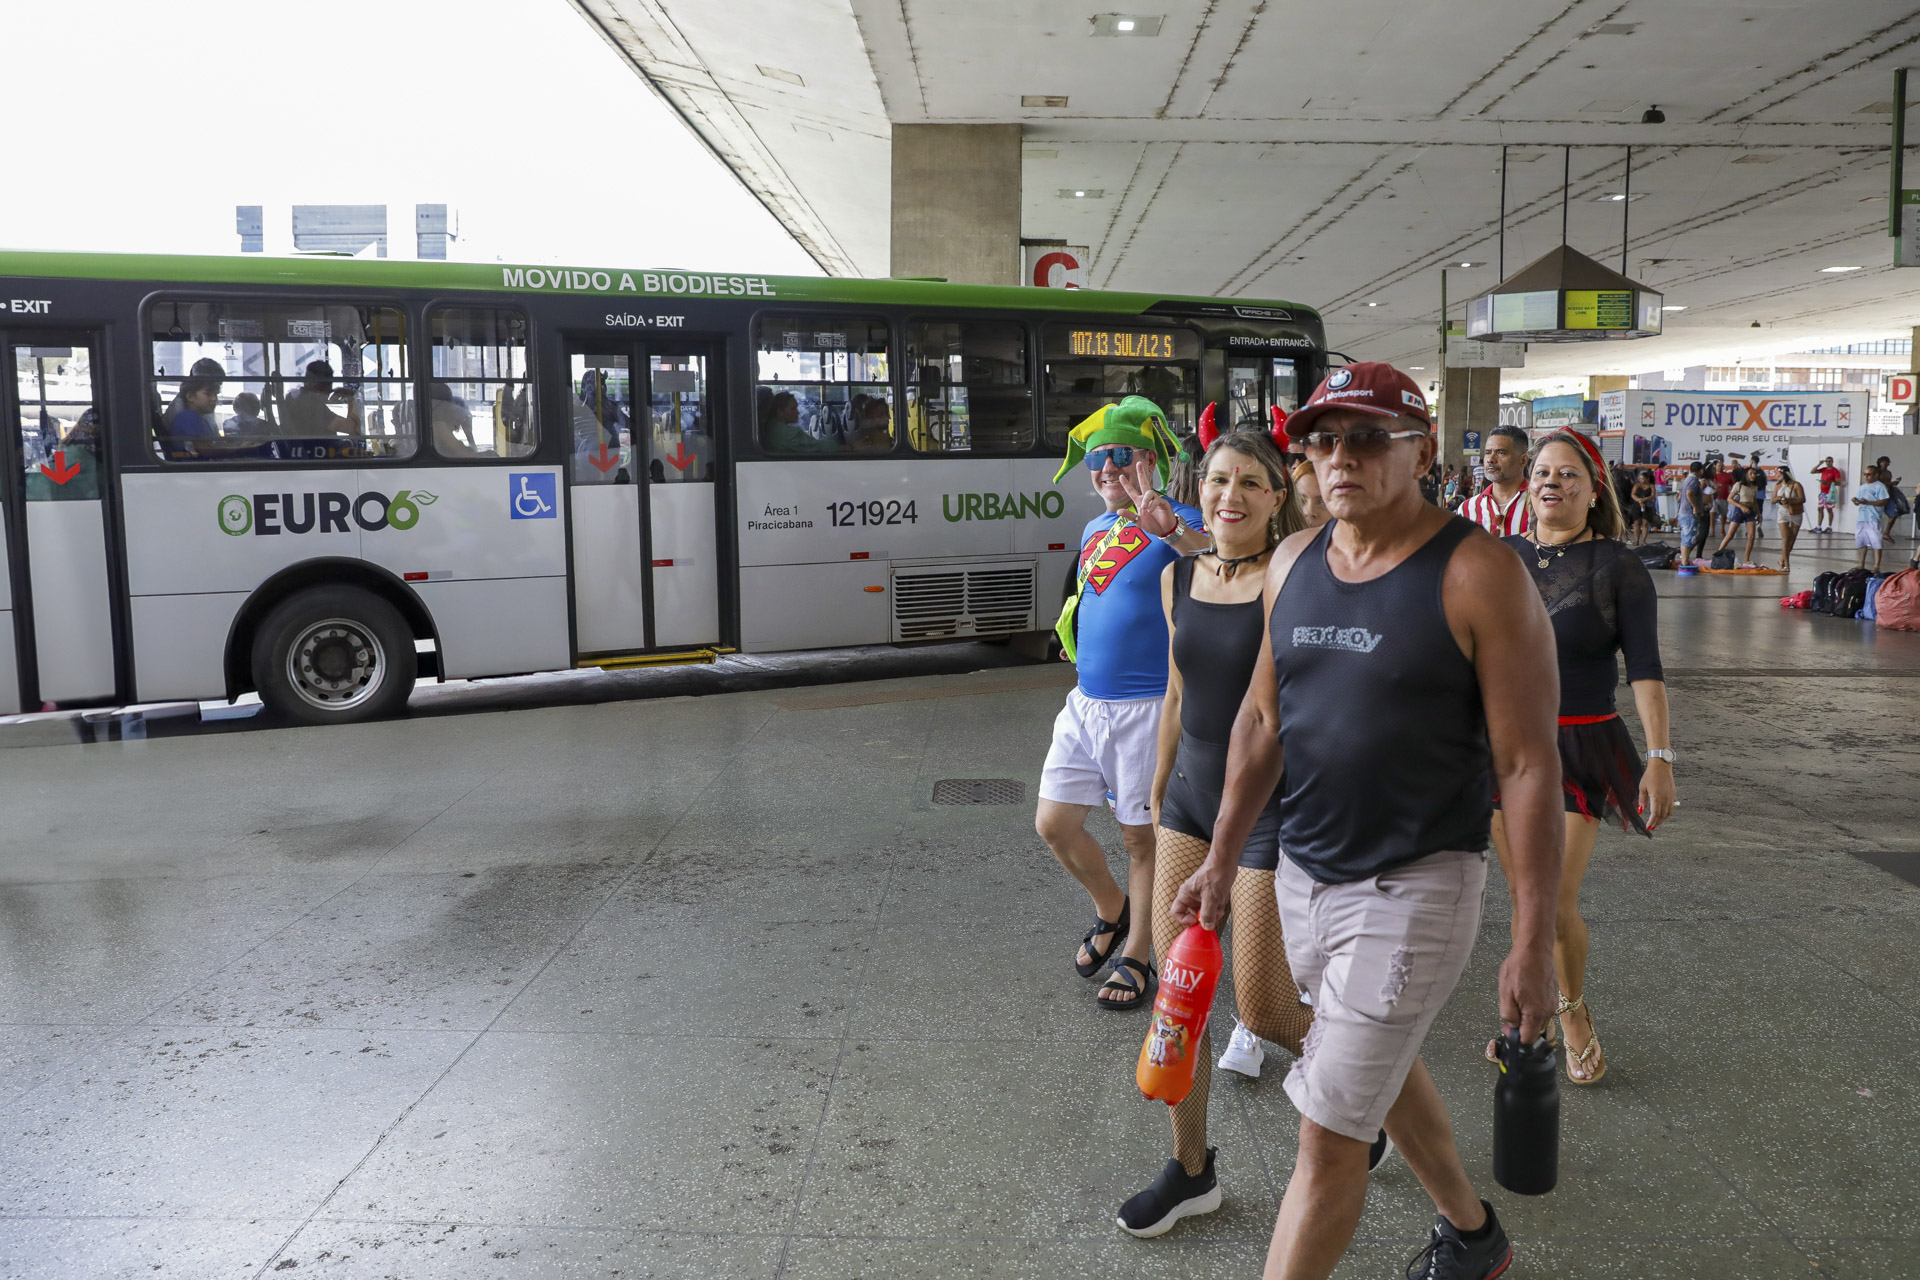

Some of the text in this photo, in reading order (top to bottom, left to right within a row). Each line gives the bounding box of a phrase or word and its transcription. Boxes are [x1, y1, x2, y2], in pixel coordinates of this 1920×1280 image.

[1033, 252, 1080, 288] C
[502, 268, 776, 296] MOVIDO A BIODIESEL
[11, 300, 51, 314] EXIT
[605, 312, 685, 327] SAÍDA EXIT
[1072, 331, 1172, 358] 107.13 SUL/L2 S
[1230, 336, 1309, 347] ENTRADA ENTRANCE
[1326, 389, 1374, 401] Motorsport
[1892, 378, 1912, 400] D
[1699, 434, 1722, 442] TUDO
[1726, 434, 1749, 443] PARA
[764, 503, 799, 516] Área 1
[826, 500, 918, 527] 121924
[943, 490, 1064, 522] URBANO
[748, 519, 813, 530] Piracicabana
[1103, 528, 1117, 548] NIKE
[1163, 958, 1204, 993] BALY
